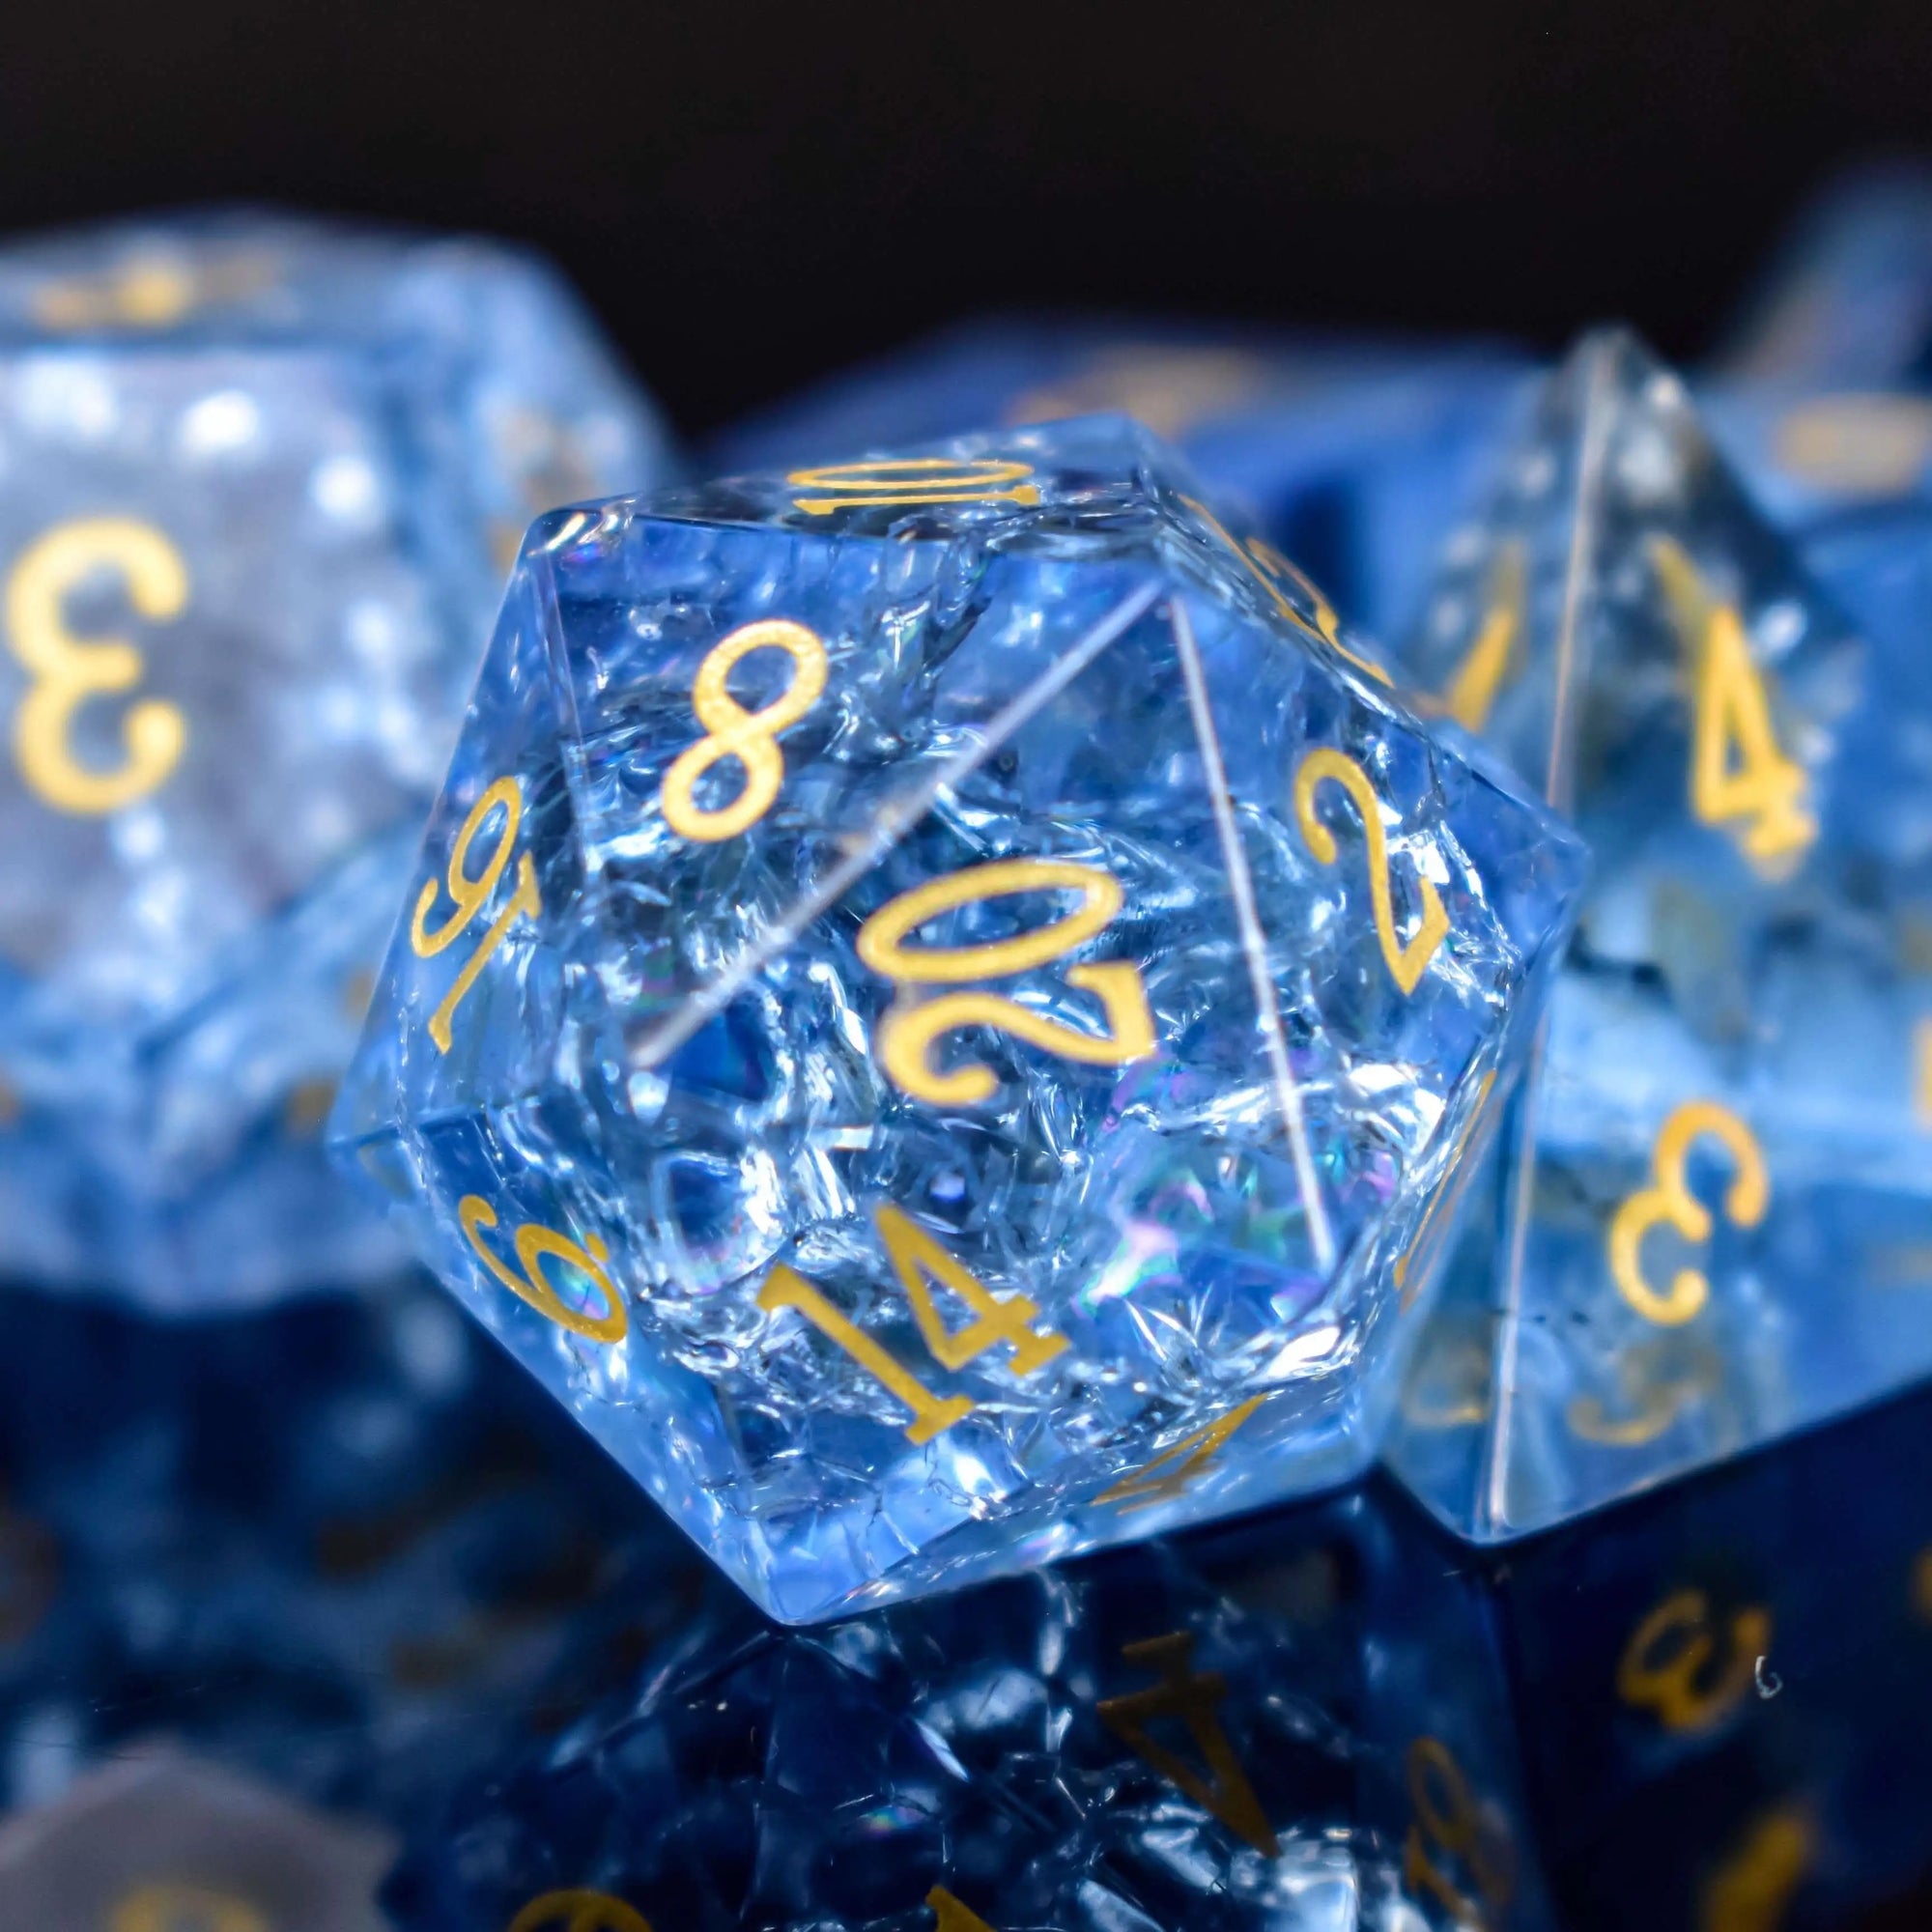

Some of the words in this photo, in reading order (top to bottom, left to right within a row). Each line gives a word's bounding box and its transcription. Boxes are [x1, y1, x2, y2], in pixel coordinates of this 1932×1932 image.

[6, 515, 188, 816] 3
[662, 618, 829, 842] 8
[856, 857, 1155, 1110] 20
[1293, 747, 1452, 996] 2
[754, 1204, 1073, 1446] 14
[1606, 1099, 1772, 1327] 3
